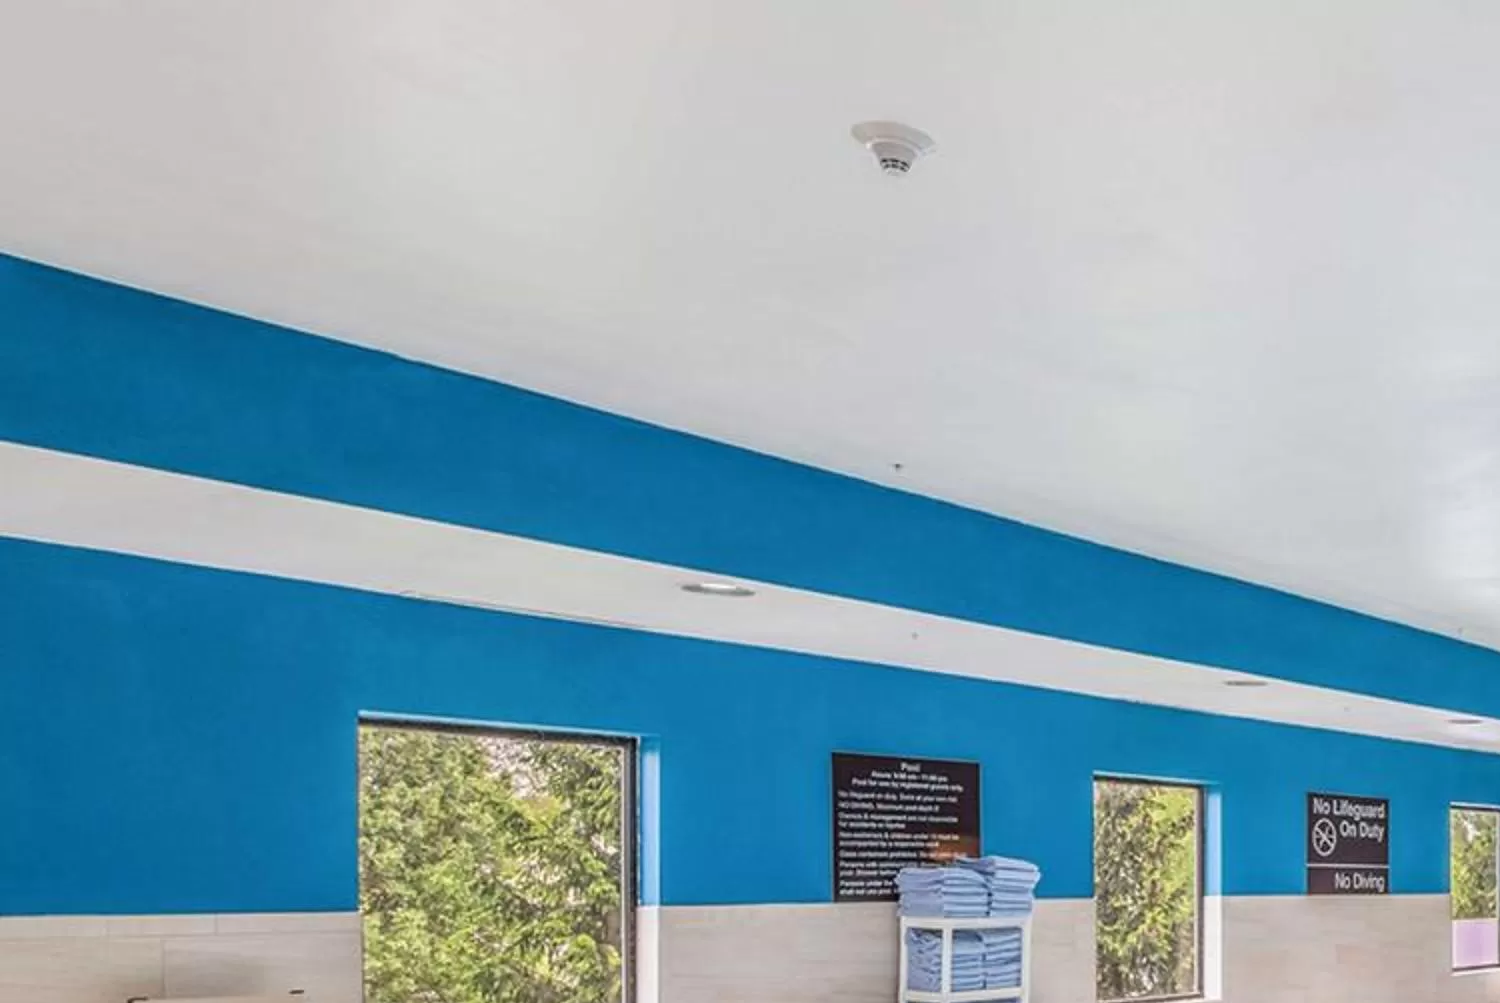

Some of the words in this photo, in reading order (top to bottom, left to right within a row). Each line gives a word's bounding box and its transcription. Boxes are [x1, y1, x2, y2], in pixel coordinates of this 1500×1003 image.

[900, 761, 921, 772] Pool
[1313, 798, 1331, 814] No
[1333, 799, 1385, 820] Lifeguard
[1340, 820, 1356, 837] On
[1359, 822, 1384, 843] Duty
[1334, 872, 1351, 888] No
[1353, 872, 1384, 892] Diving
